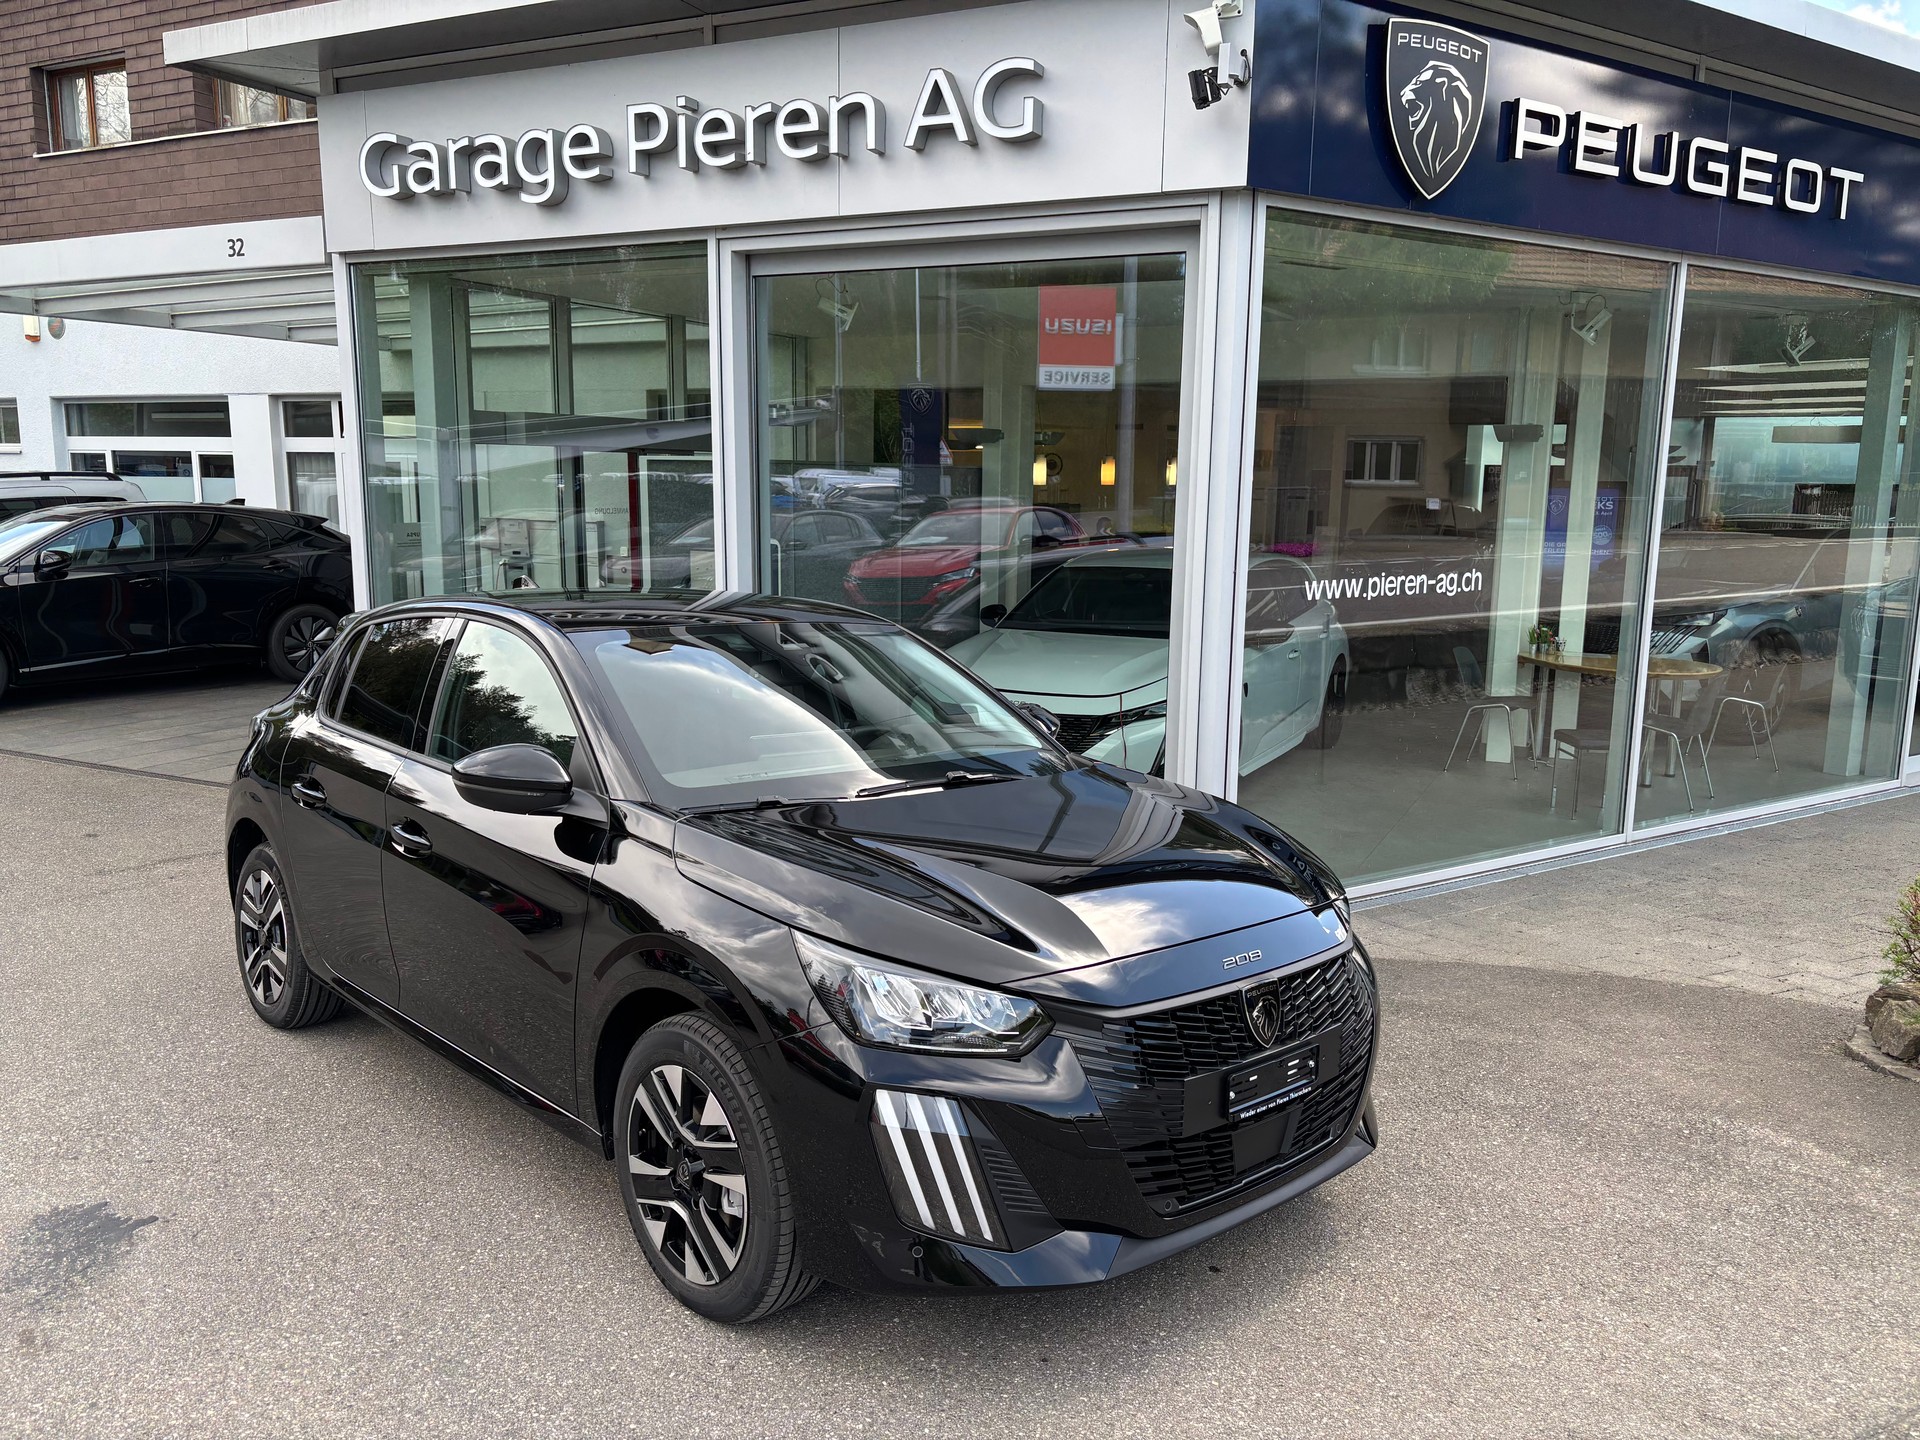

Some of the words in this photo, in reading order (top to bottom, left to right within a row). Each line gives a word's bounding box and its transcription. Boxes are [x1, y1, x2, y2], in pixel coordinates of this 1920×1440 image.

[1397, 32, 1483, 63] PEUGEOT
[359, 132, 614, 205] Garage
[626, 92, 885, 177] Pieren
[903, 56, 1045, 152] AG
[1513, 97, 1865, 220] PEUGEOT
[227, 238, 245, 258] 32
[1305, 568, 1482, 601] www.pieren-ag.ch
[1222, 949, 1262, 970] 208
[1247, 984, 1277, 998] PEUGEOT
[702, 1059, 753, 1146] MICHELIN
